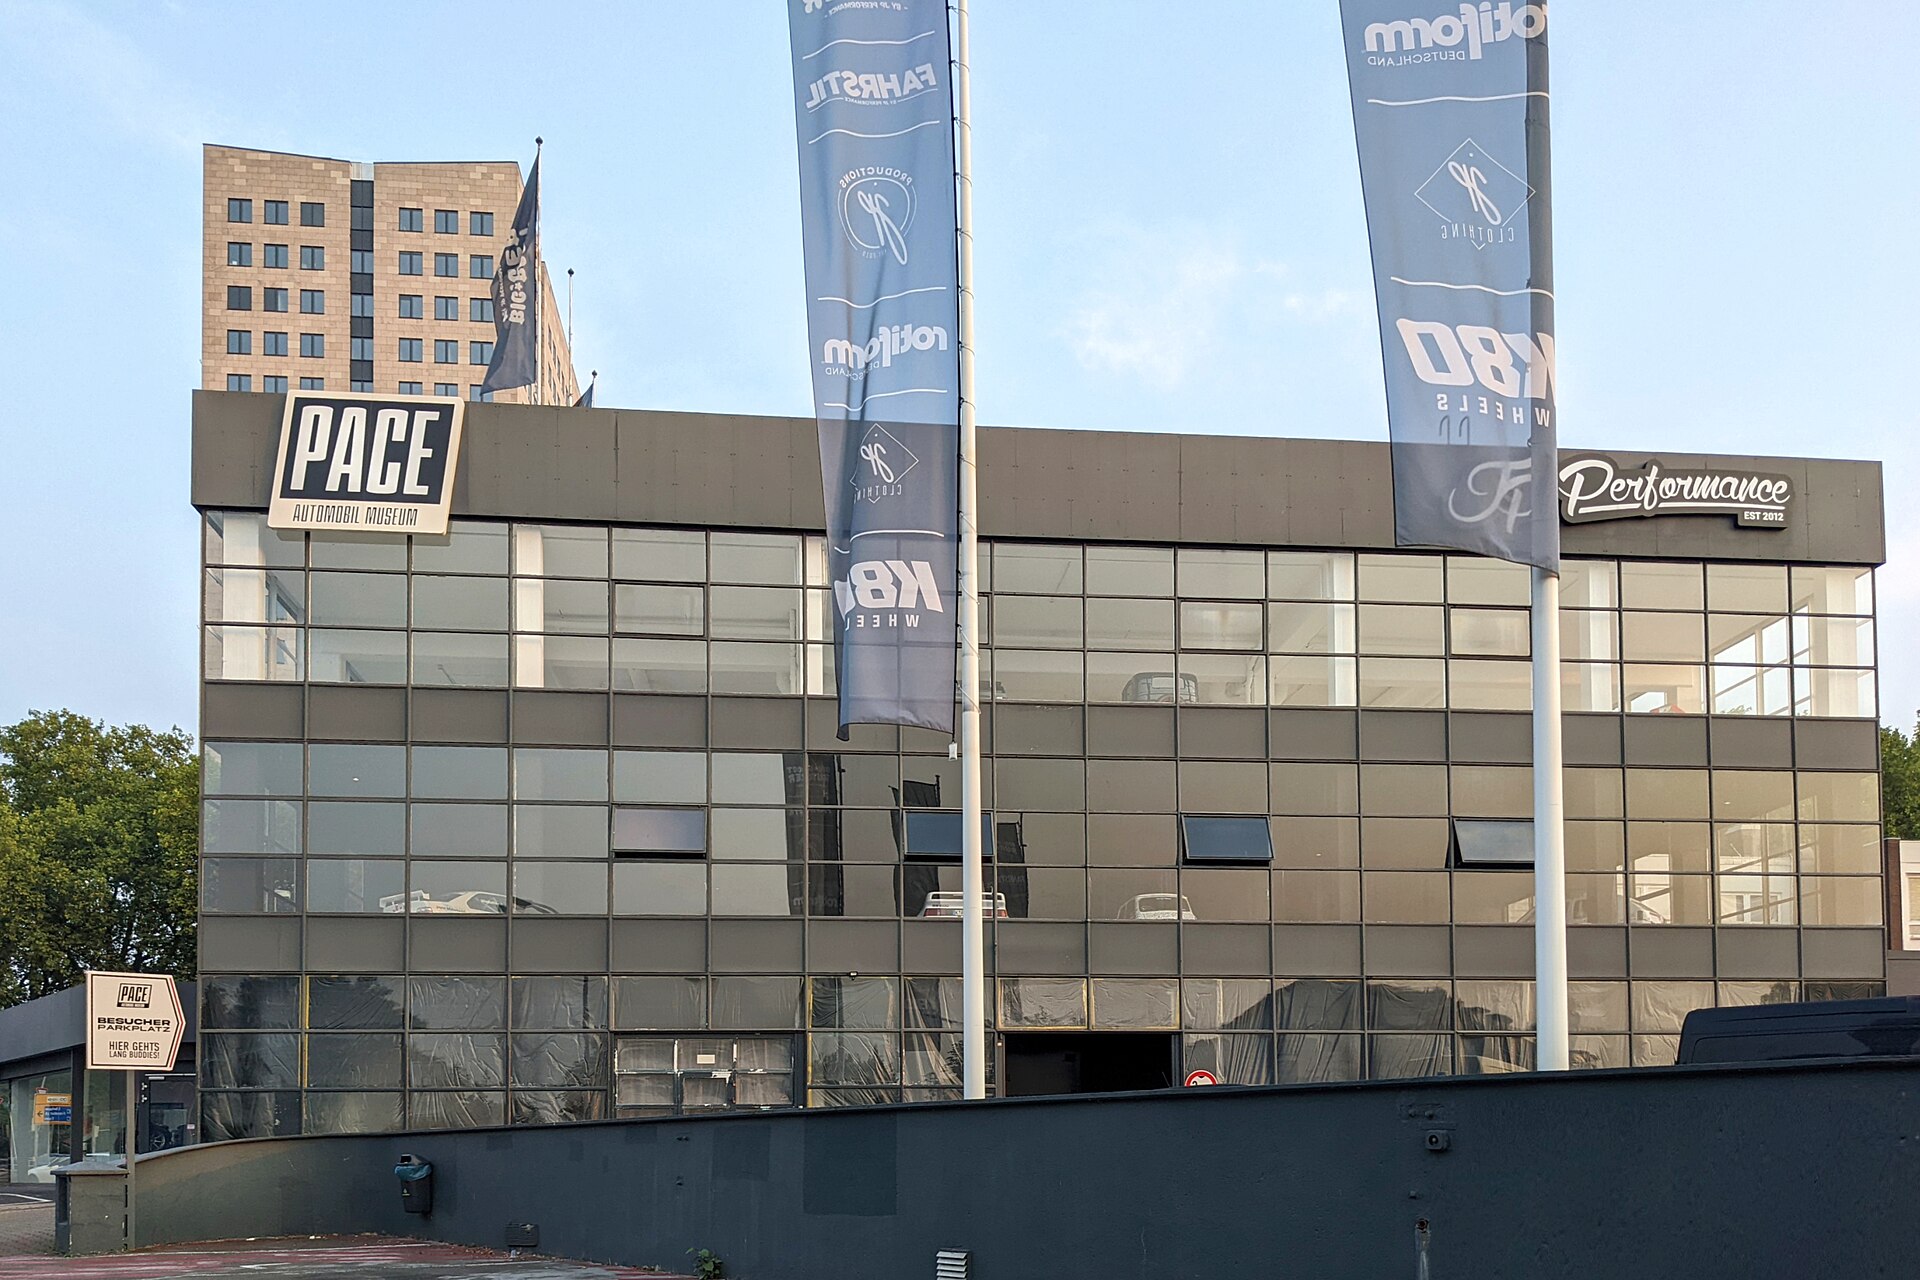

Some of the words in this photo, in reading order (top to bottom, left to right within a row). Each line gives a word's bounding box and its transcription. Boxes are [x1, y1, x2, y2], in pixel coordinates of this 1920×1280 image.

[290, 405, 440, 495] PACE
[1558, 459, 1790, 517] Performance
[293, 504, 360, 524] AUTOMOBIL
[365, 506, 418, 526] MUSEUM
[1743, 511, 1760, 521] EST
[1762, 511, 1784, 522] 2012
[121, 986, 149, 1002] PACE
[98, 1017, 171, 1026] BESUCHER
[98, 1024, 171, 1032] PARKPLATZ
[109, 1041, 129, 1051] HIER
[132, 1042, 160, 1051] GEHTS
[129, 1051, 160, 1059] BUDDIES!
